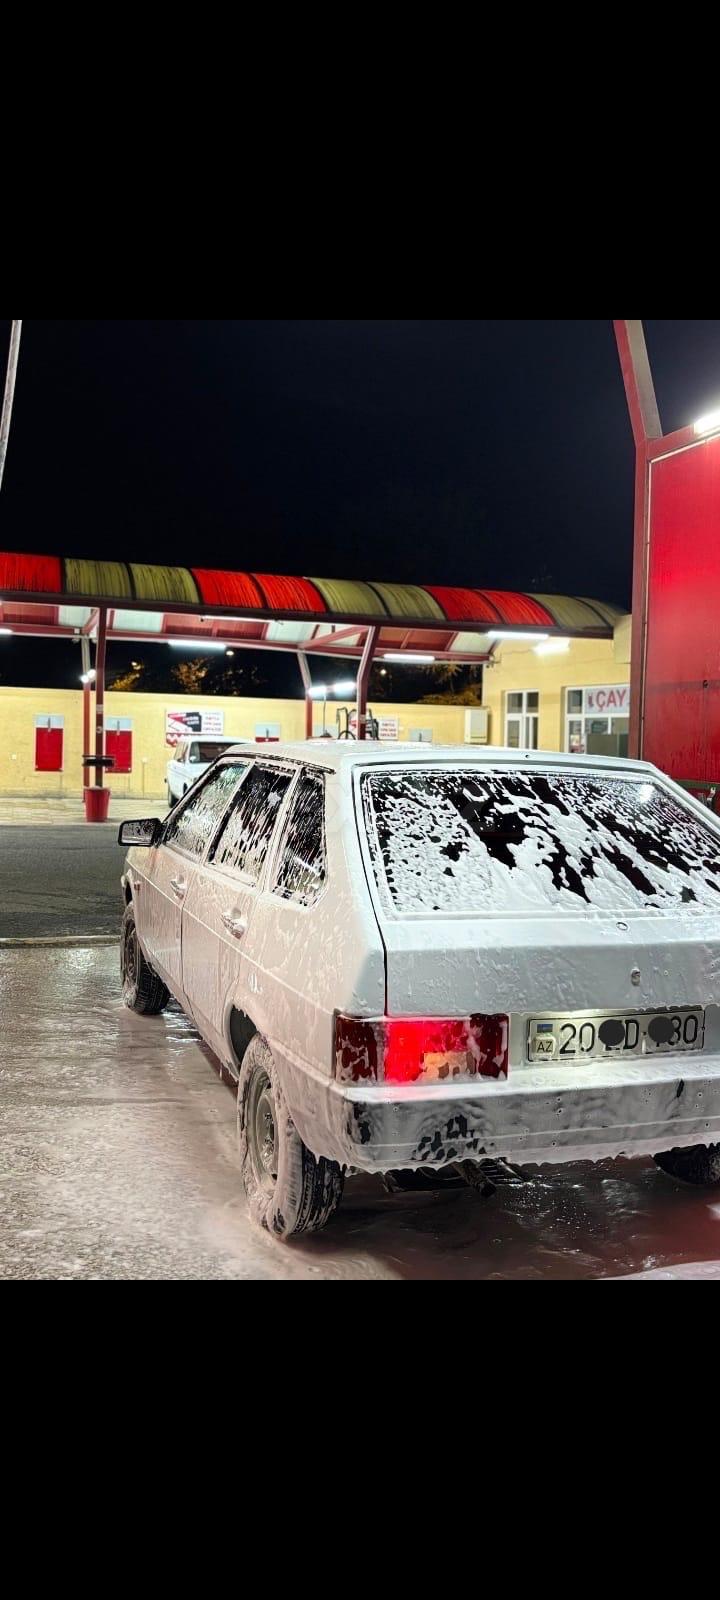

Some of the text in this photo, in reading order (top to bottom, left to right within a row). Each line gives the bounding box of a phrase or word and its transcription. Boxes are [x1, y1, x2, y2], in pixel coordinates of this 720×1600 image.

[596, 688, 627, 712] ÇAY
[536, 1041, 553, 1053] AZ
[559, 1022, 596, 1054] 20
